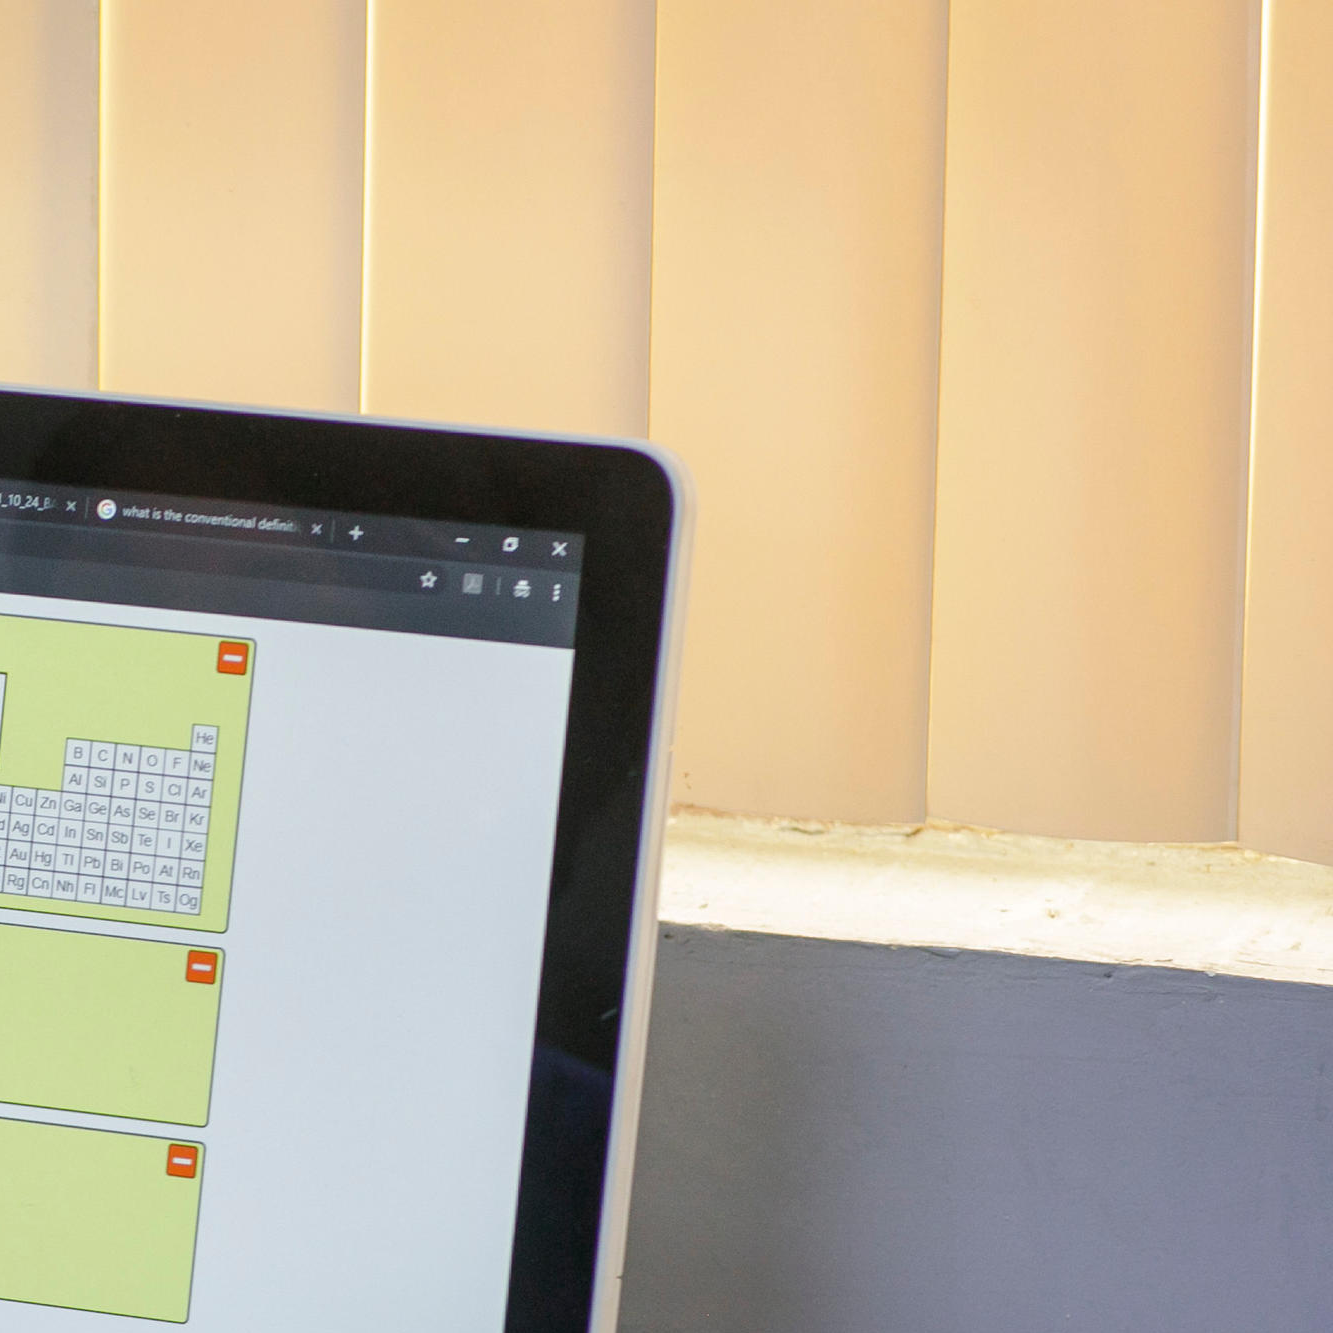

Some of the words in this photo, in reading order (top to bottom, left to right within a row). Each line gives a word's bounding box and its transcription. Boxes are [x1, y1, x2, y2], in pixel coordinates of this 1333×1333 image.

[122, 506, 150, 519] what
[152, 508, 162, 521] is
[164, 509, 182, 522] the
[184, 512, 256, 530] conventional
[258, 518, 299, 534] definit
[196, 732, 214, 745] He
[73, 746, 83, 759] B
[97, 749, 108, 762] C
[123, 752, 133, 764] N
[146, 754, 158, 767] O
[173, 757, 181, 769] F
[193, 760, 211, 772] Ne
[68, 773, 82, 785] Al
[94, 776, 106, 788] Si
[120, 778, 130, 790] P
[145, 781, 155, 793] S
[167, 784, 181, 796] Cl
[191, 786, 207, 799] Ar
[15, 794, 33, 807] Cu
[40, 796, 57, 809] Zn
[63, 799, 82, 812] Ga
[88, 802, 107, 815] Ge
[113, 805, 130, 818] As
[138, 807, 155, 820] Se
[165, 810, 179, 822] Br
[189, 813, 204, 825] Kr
[12, 821, 29, 836] Ag
[37, 823, 55, 836] Cd
[64, 826, 76, 839] In
[86, 828, 103, 841] Sn
[111, 831, 128, 844] Sb
[137, 834, 152, 847] Te
[185, 839, 203, 852] Xe
